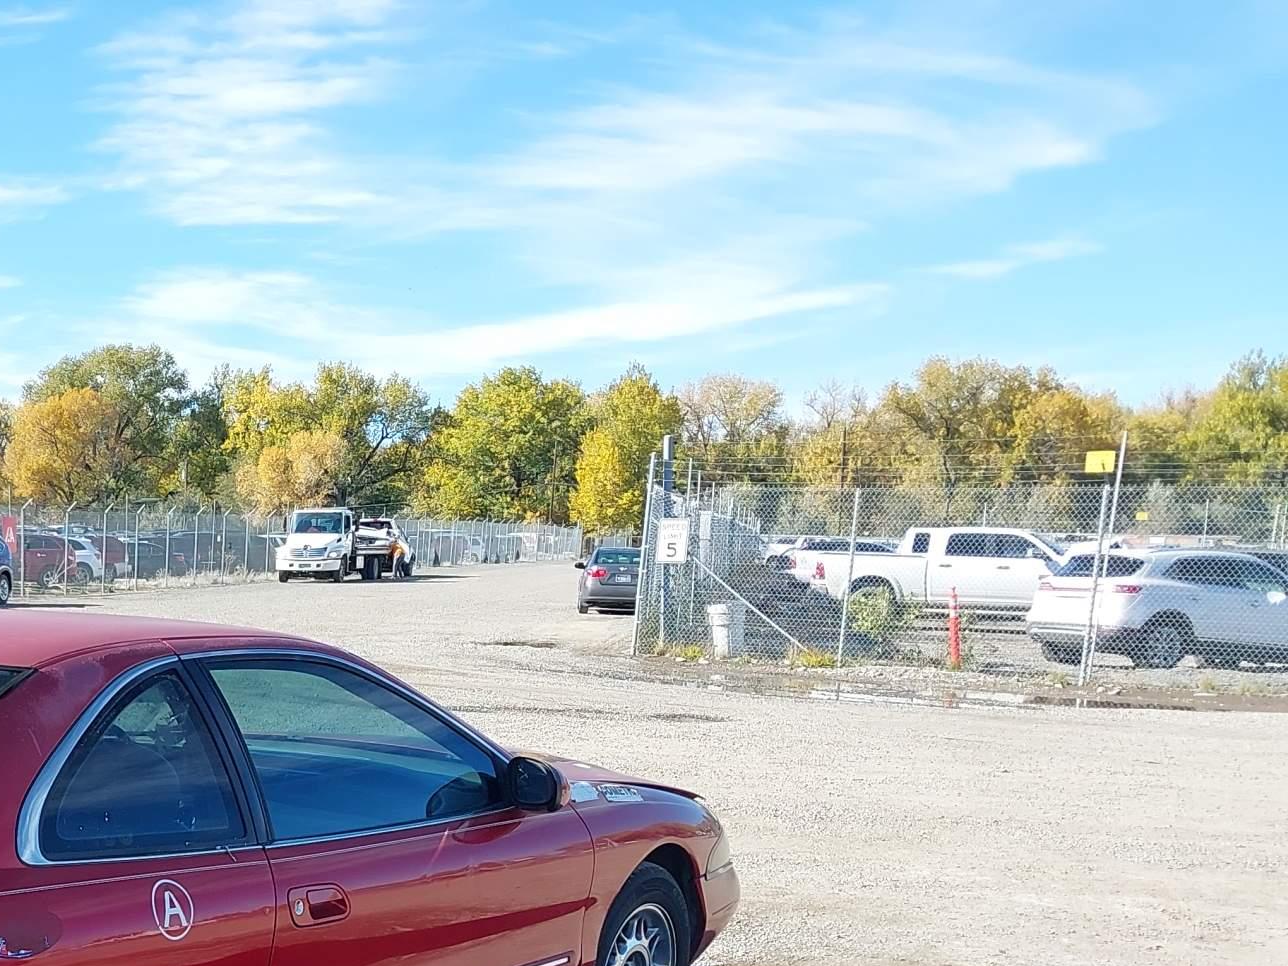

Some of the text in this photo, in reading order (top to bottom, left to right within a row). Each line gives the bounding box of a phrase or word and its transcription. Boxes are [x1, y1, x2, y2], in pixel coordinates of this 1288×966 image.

[662, 523, 686, 531] SPEED
[666, 542, 677, 557] 5
[163, 890, 189, 928] A
